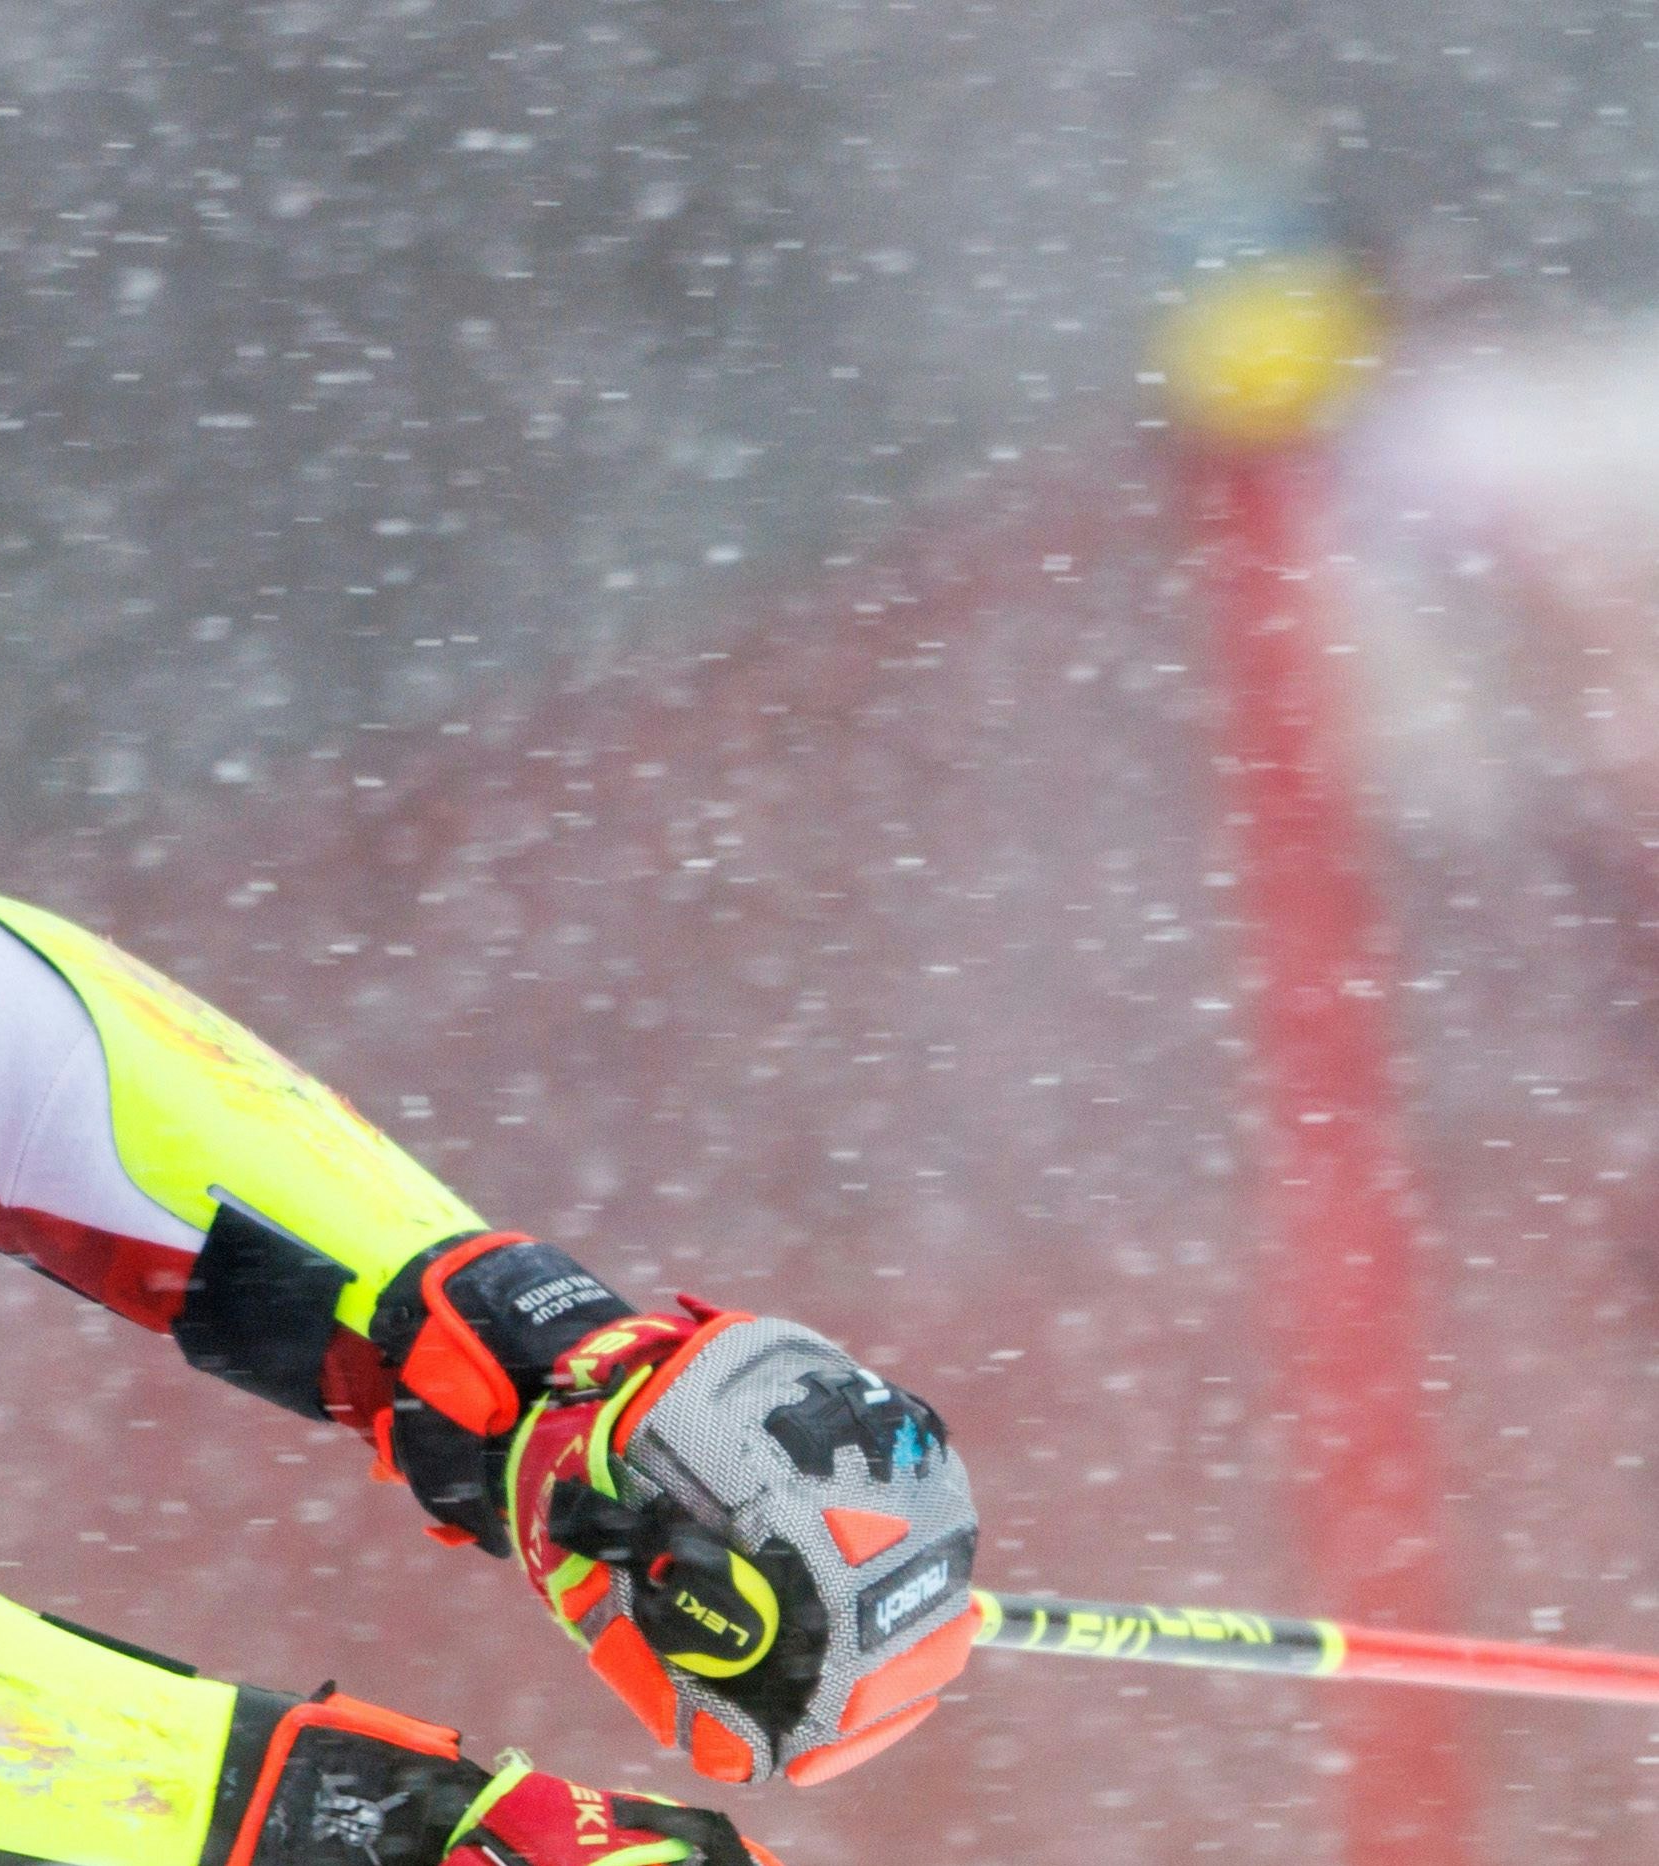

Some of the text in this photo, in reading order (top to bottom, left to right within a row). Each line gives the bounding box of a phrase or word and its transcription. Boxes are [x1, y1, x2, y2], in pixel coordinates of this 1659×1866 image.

[515, 1275, 602, 1313] WARRIOR
[675, 1590, 750, 1647] LEKI
[567, 1780, 610, 1846] EKI
